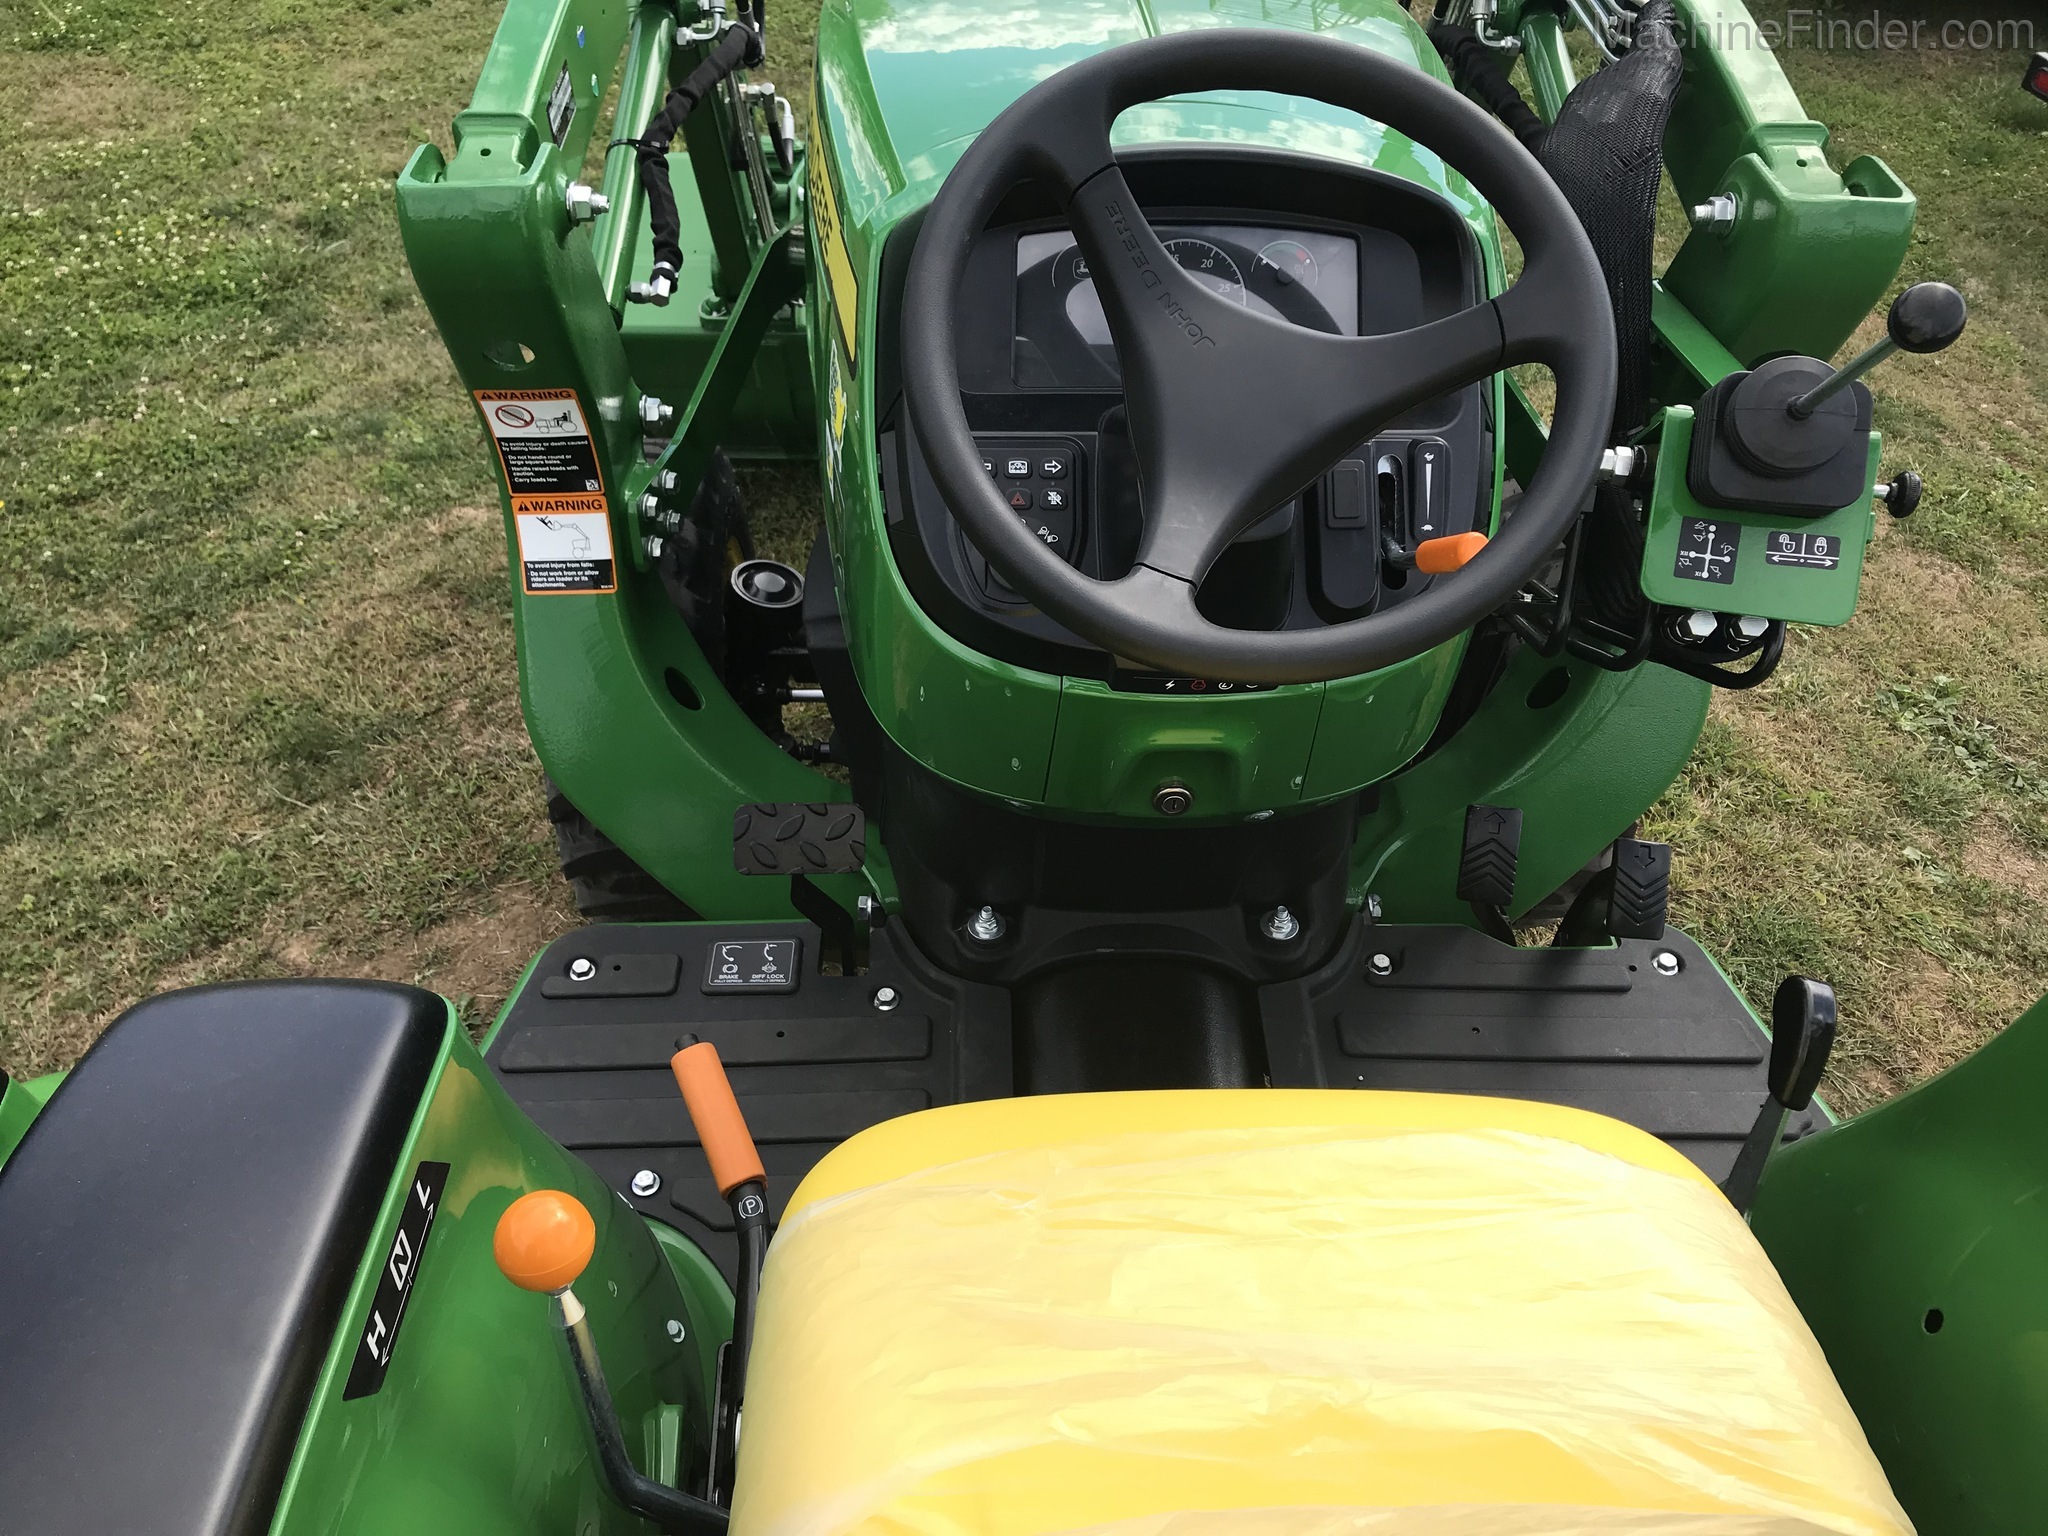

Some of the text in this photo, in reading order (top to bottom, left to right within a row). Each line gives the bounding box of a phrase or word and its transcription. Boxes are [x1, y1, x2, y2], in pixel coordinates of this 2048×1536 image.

[1200, 258, 1214, 268] 20
[1105, 200, 1216, 348] JOHN DEERE
[1218, 284, 1231, 292] 25
[493, 390, 572, 400] WARNING
[530, 499, 602, 511] WARNING
[746, 1199, 756, 1214] P
[366, 1180, 431, 1360] H N L
